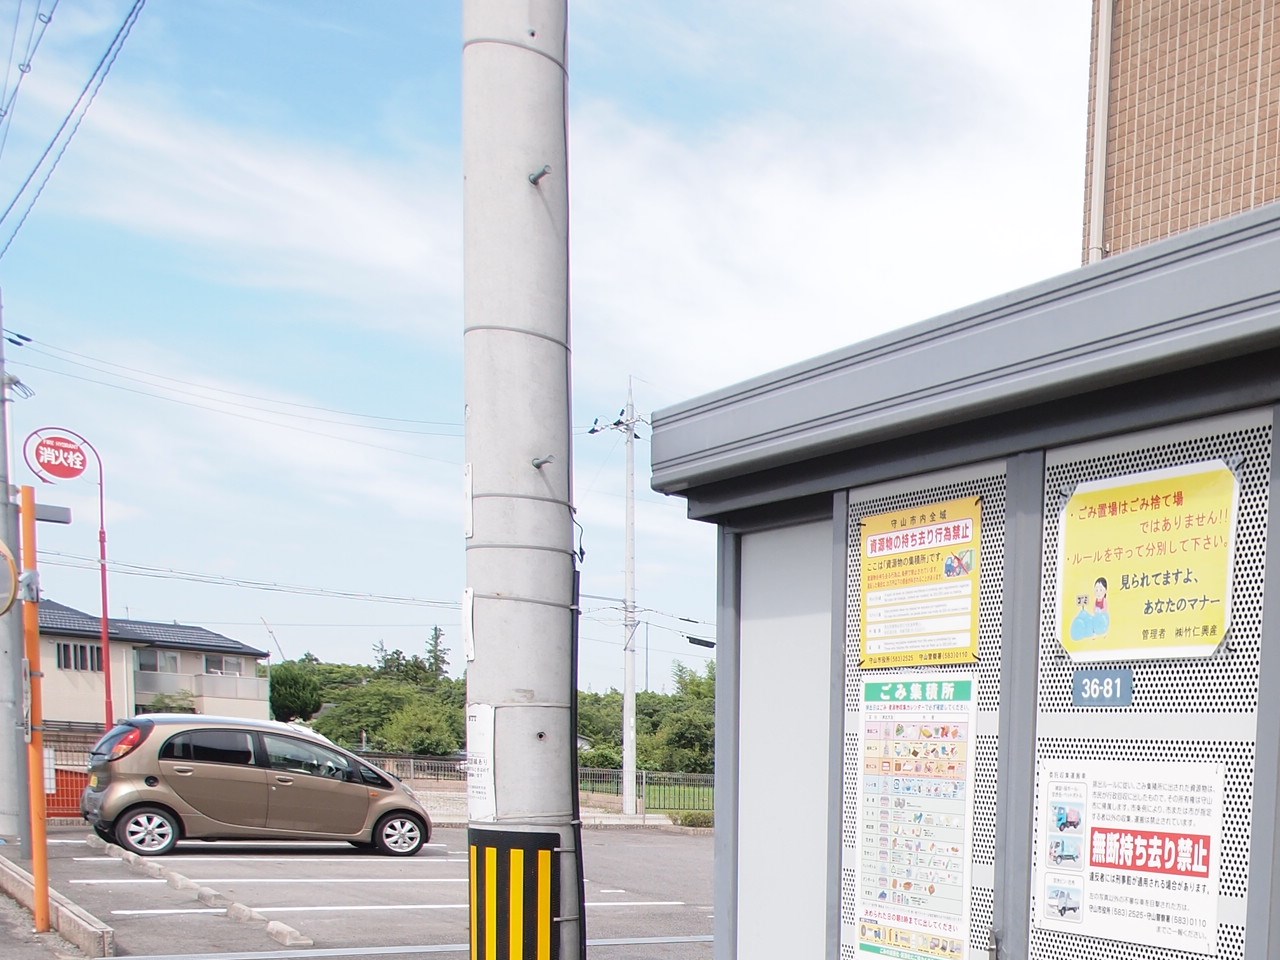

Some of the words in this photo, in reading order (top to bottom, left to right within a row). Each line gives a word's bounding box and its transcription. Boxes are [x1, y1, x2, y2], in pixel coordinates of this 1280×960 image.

[38, 445, 84, 470] 消火栓
[890, 509, 947, 529] 守山市内全域
[870, 523, 970, 554] 資源物の持ち去り行為禁止
[1119, 568, 1199, 591] 見られてますよ、
[1143, 594, 1221, 616] あなたのマナー
[1141, 627, 1166, 640] 管理者
[880, 682, 955, 701] ごみ集積所
[1081, 677, 1121, 698] 36-81
[1092, 830, 1208, 873] 無断持ち去り禁止
